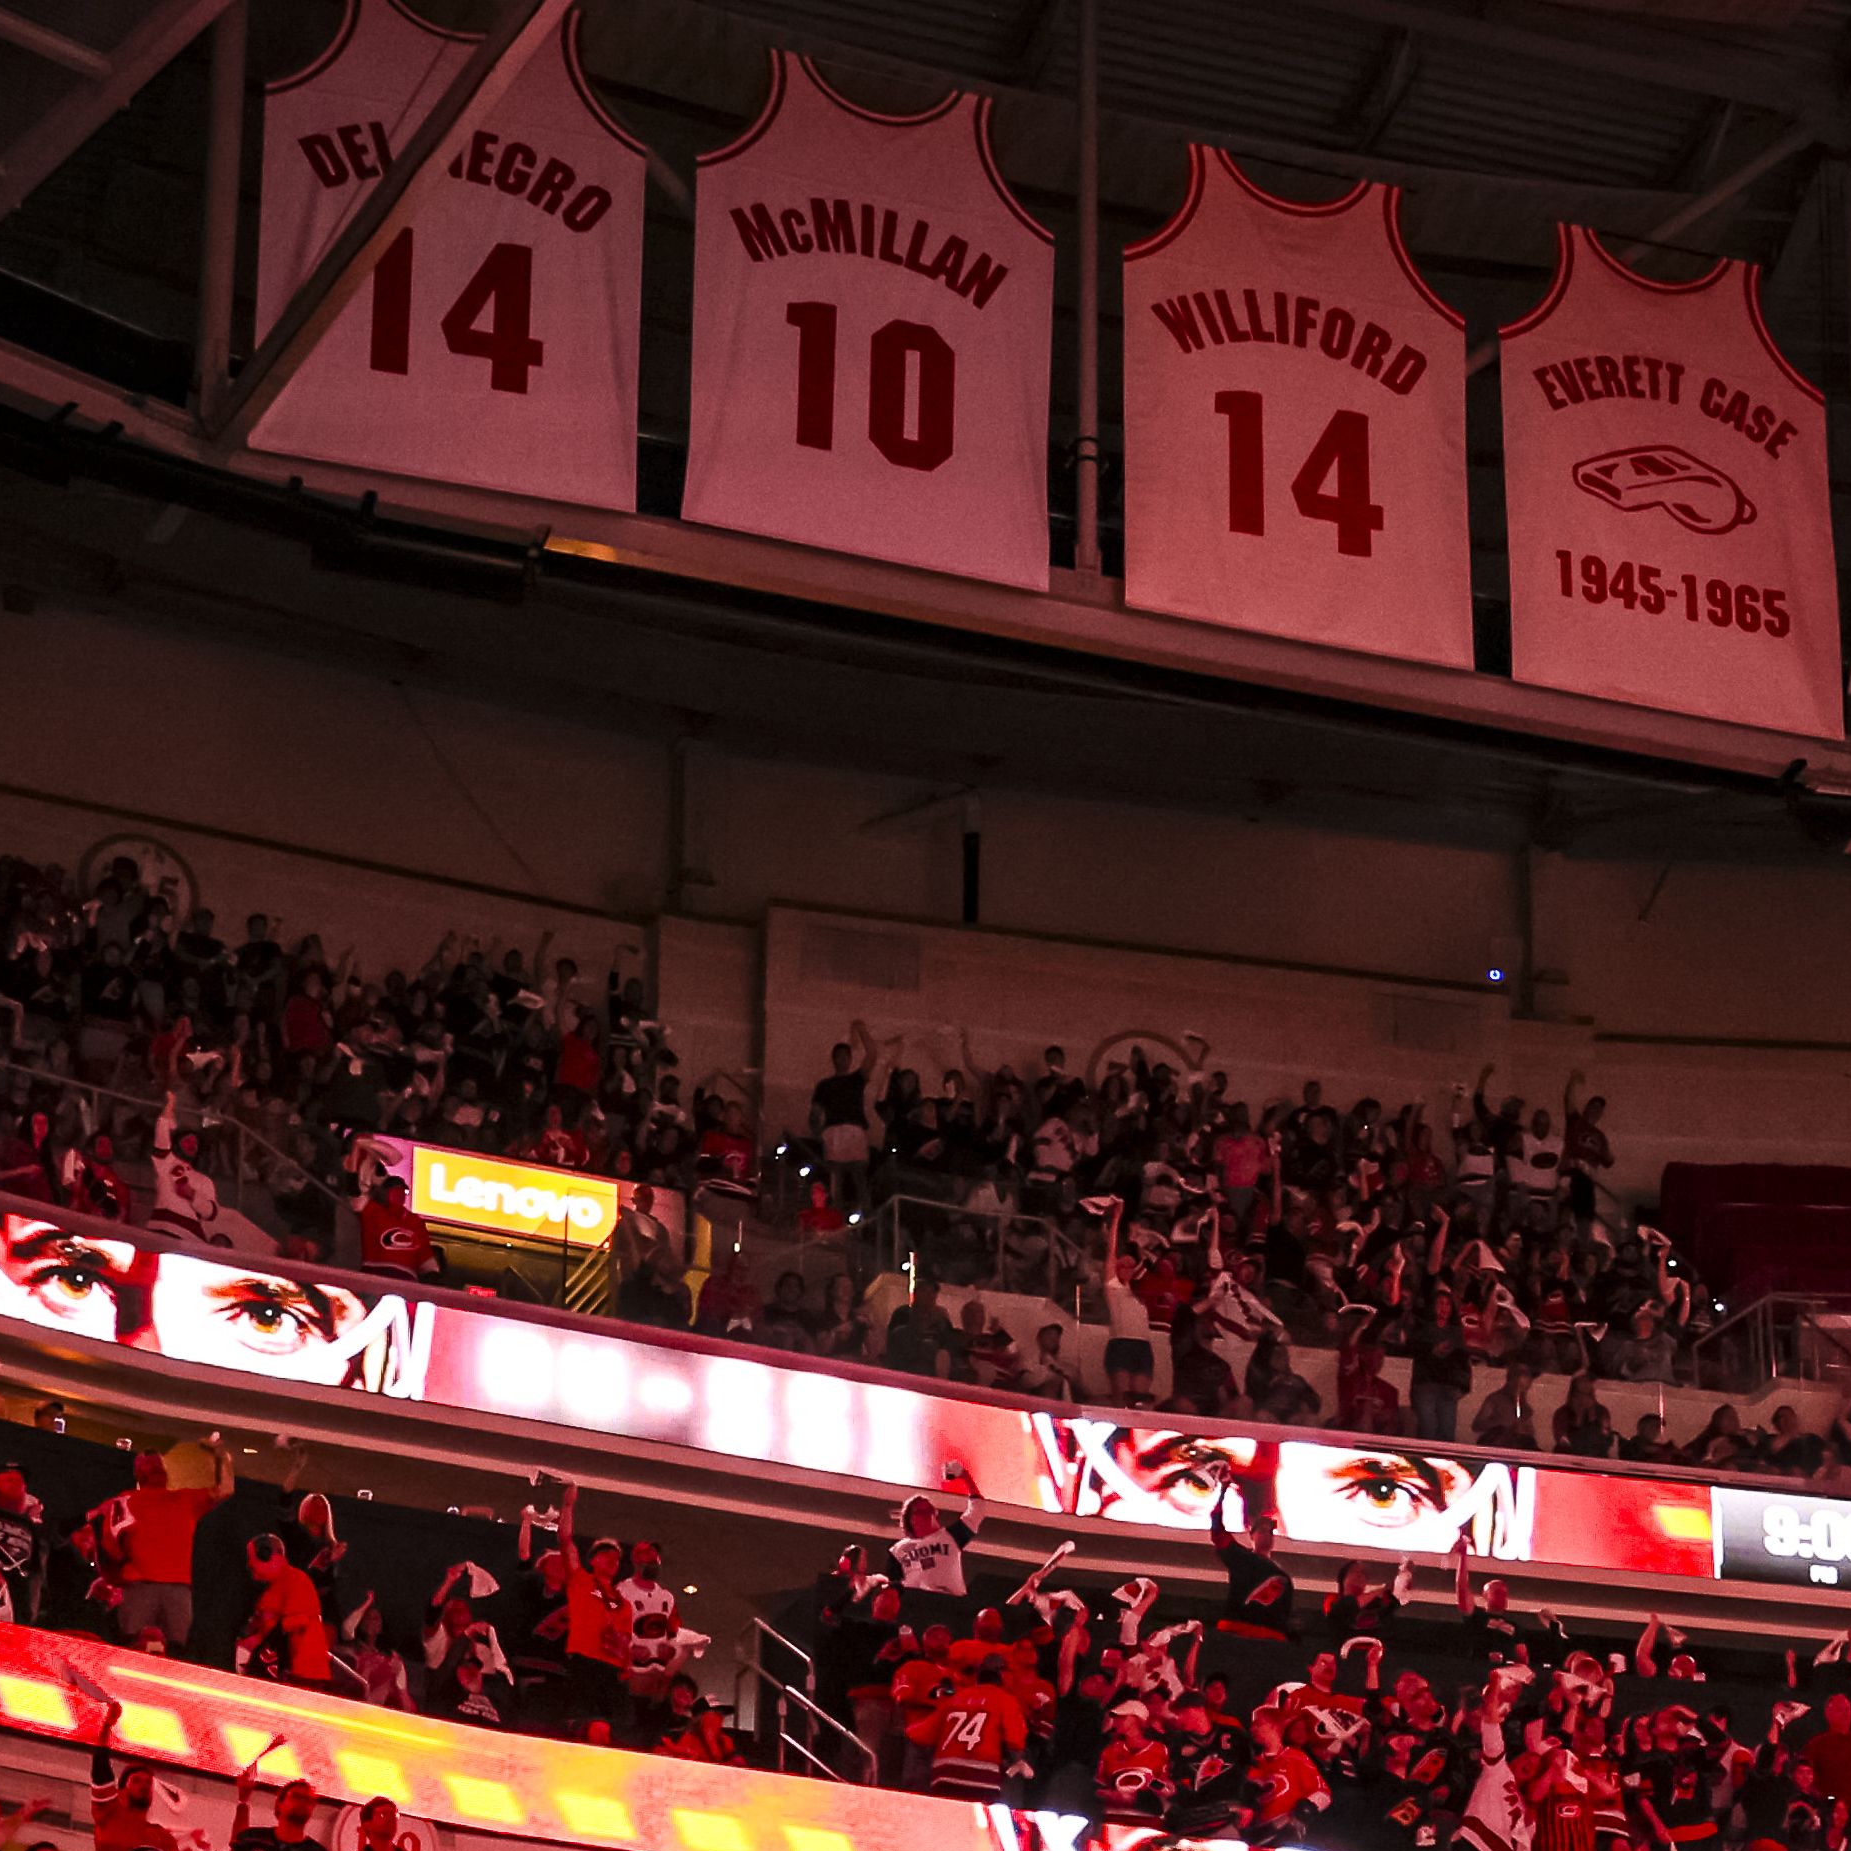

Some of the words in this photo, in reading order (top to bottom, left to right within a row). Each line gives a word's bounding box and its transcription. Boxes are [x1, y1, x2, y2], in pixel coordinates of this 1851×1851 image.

[730, 198, 1009, 310] McMILLAN
[370, 227, 543, 395] 14
[1151, 288, 1428, 396] WILLIFORD
[786, 301, 955, 472] 10
[1532, 356, 1686, 412] EVERETT
[1699, 378, 1799, 460] CASE
[1214, 389, 1385, 558] 14
[1554, 549, 1791, 639] 1945-1965
[428, 1163, 603, 1224] Lenovo
[940, 1711, 988, 1752] 74
